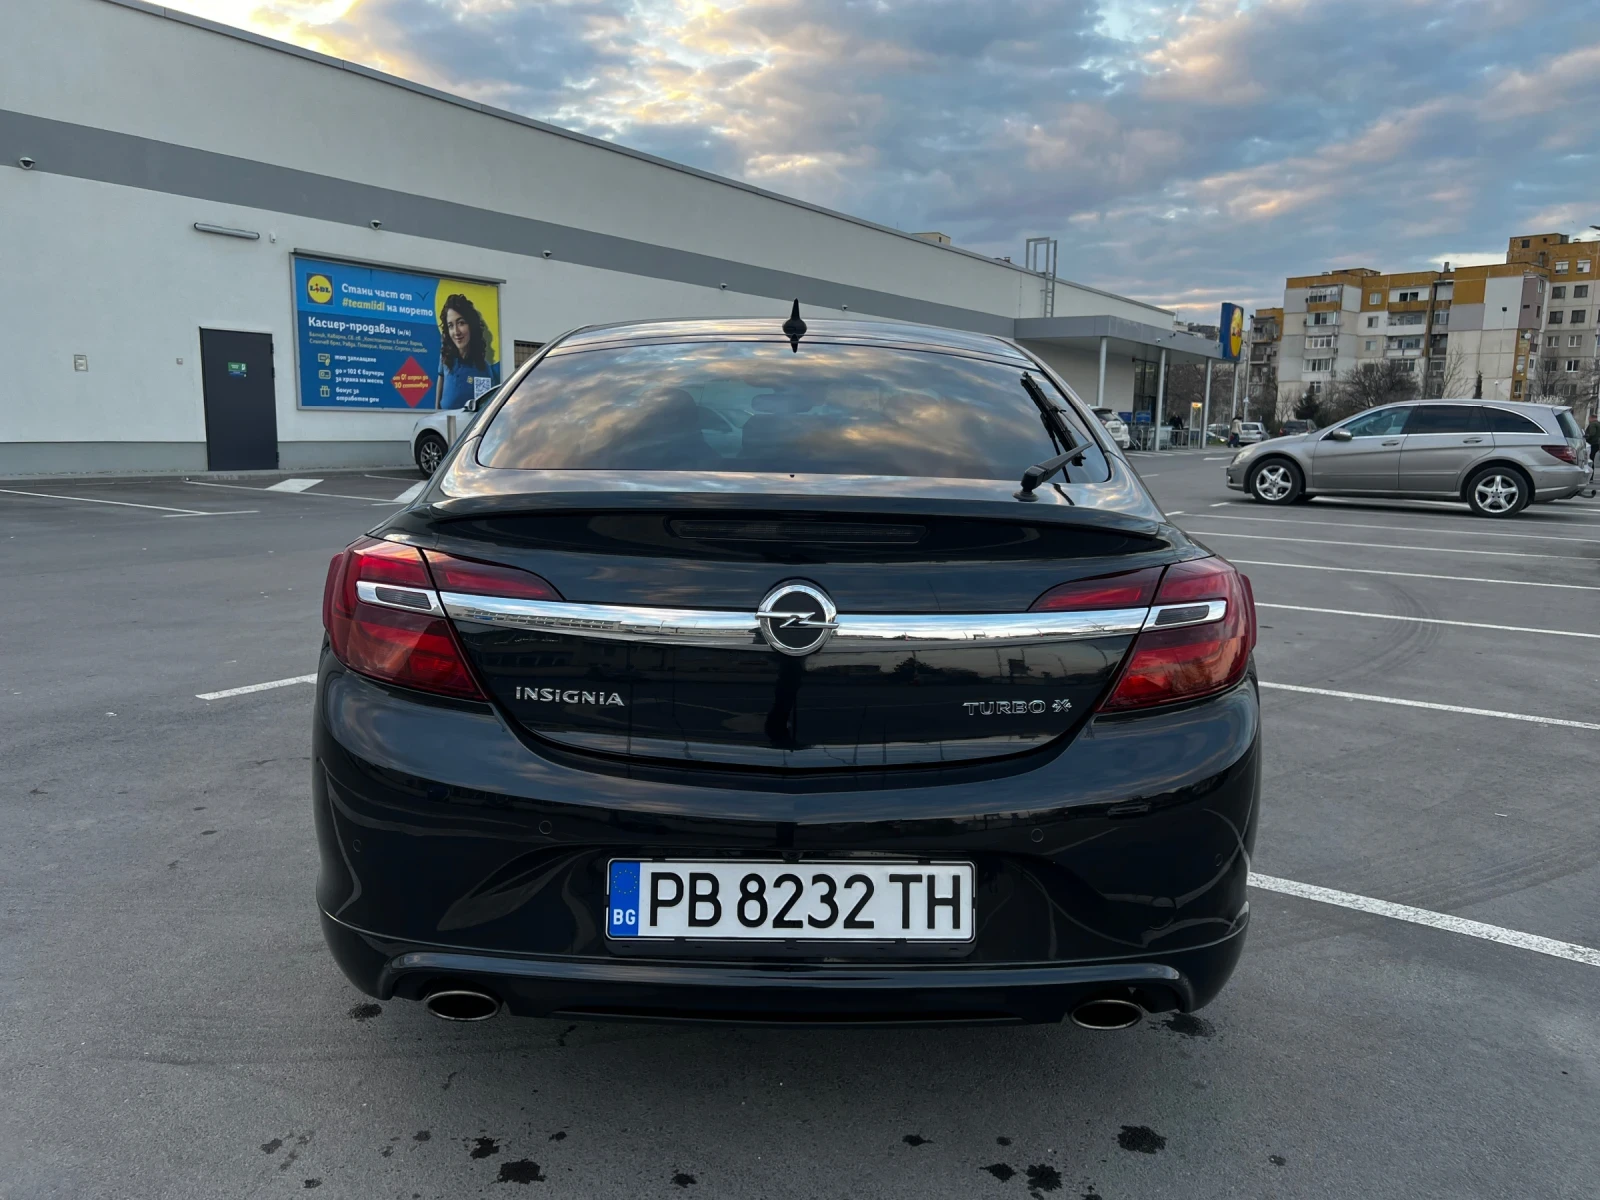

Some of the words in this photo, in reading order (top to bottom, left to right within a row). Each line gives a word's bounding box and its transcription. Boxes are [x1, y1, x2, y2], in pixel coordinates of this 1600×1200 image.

[341, 283, 373, 296] Стани
[374, 289, 398, 300] част
[399, 292, 413, 301] от
[342, 298, 385, 311] #teamlidl
[386, 304, 397, 313] на
[399, 305, 434, 317] морето
[308, 316, 396, 335] Касиер-продавач
[515, 686, 625, 706] INSIGNIA
[962, 699, 1046, 716] TURBO
[649, 872, 722, 928] PB
[736, 873, 875, 929] 8232
[888, 874, 961, 930] TH
[613, 908, 636, 926] BG
